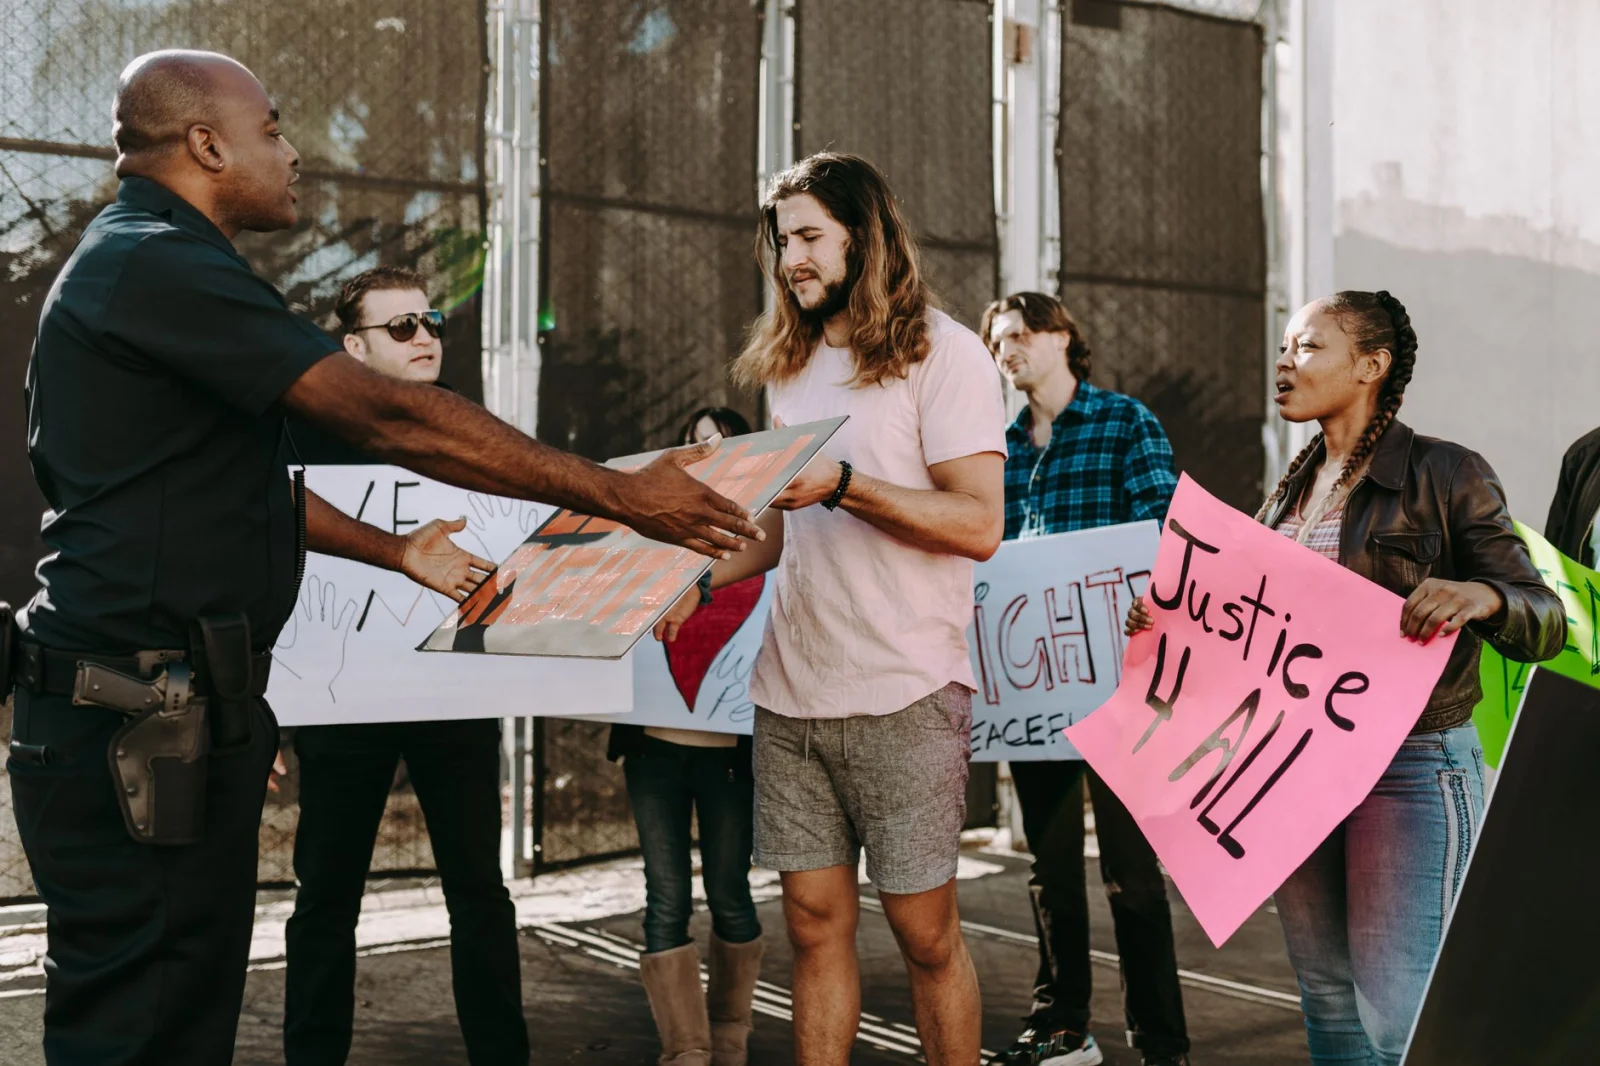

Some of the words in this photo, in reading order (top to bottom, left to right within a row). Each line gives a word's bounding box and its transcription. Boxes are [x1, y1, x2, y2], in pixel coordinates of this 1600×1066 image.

[974, 567, 1152, 706] IGHT
[1151, 518, 1370, 732] Justice
[971, 712, 1074, 753] EACEF
[1132, 633, 1191, 755] 4
